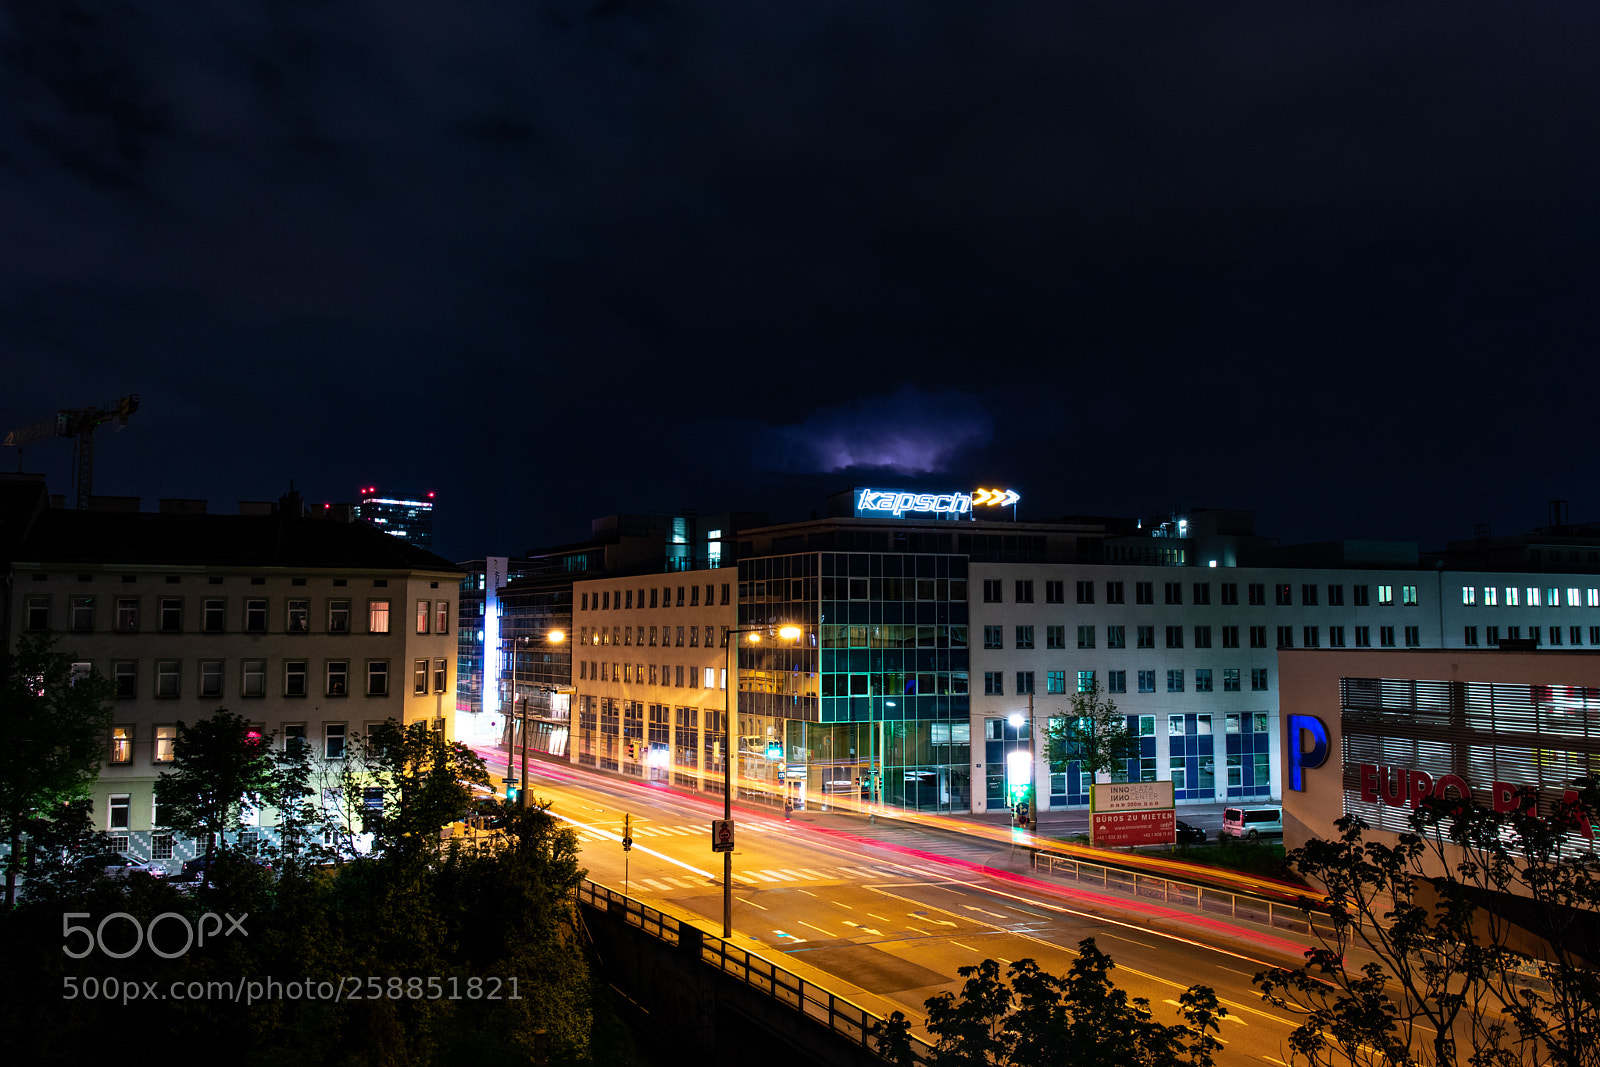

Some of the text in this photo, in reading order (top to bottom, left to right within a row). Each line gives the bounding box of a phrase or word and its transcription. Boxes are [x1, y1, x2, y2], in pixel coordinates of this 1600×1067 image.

[858, 488, 971, 515] kapsch
[1287, 713, 1332, 792] P
[1096, 815, 1124, 823] BÜROS
